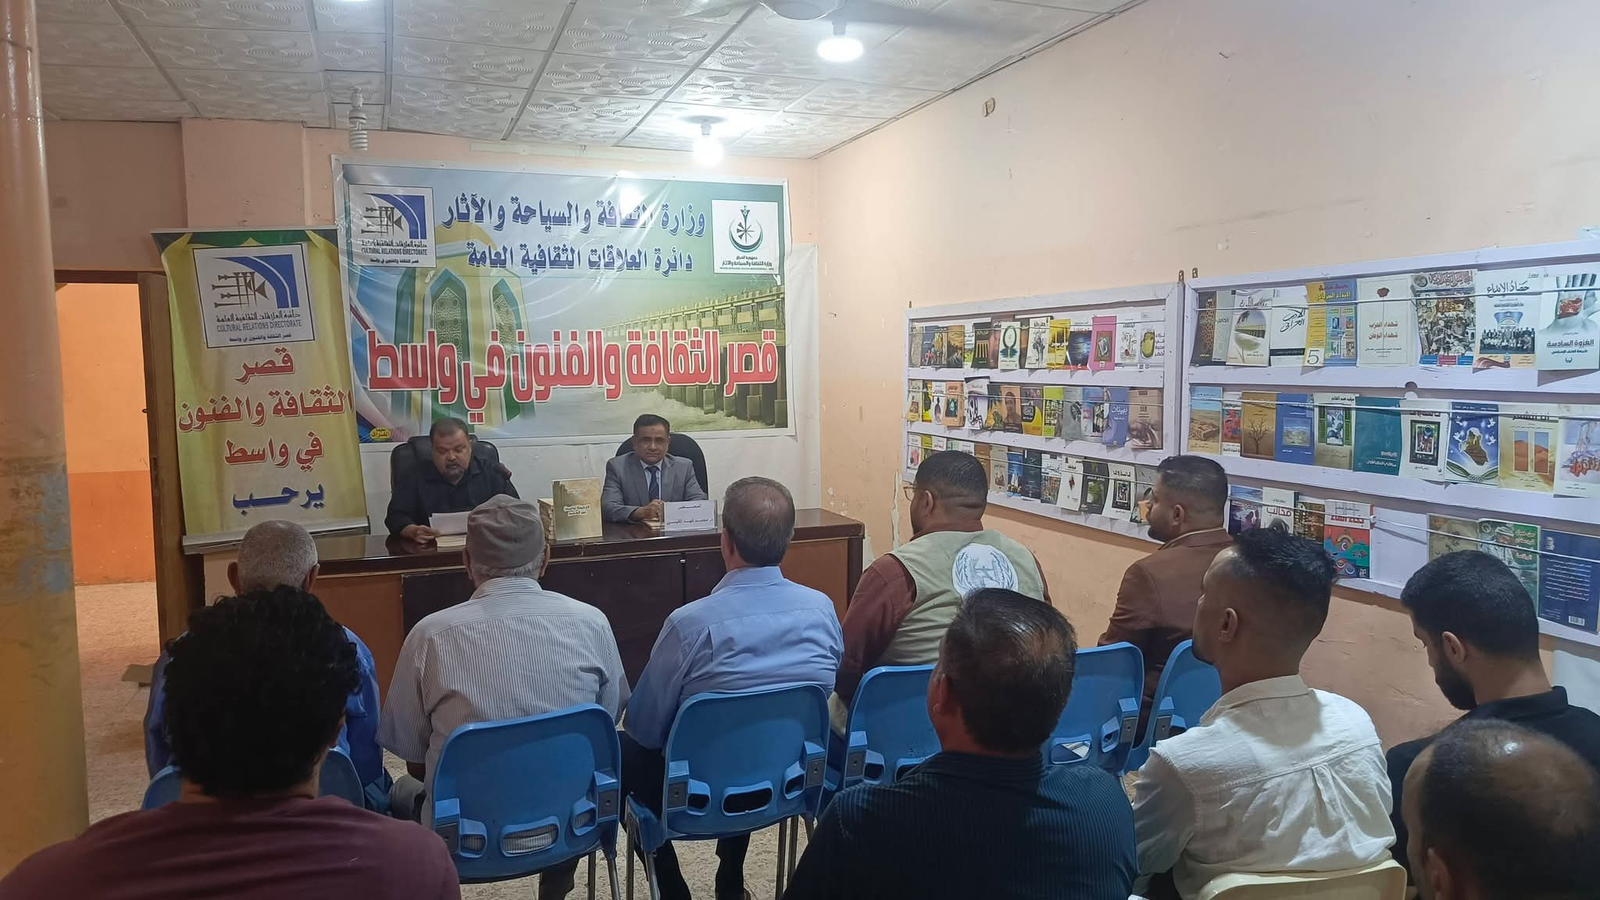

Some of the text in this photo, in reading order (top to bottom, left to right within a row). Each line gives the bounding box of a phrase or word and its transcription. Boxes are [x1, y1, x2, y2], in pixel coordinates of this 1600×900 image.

[441, 192, 506, 230] والآثار
[510, 196, 591, 233] والسياحة
[661, 203, 706, 237] وزارة
[402, 248, 428, 256] DIRECTORATE
[467, 242, 693, 277] دائرة العلاقات الثقافية العامة
[216, 319, 302, 332] CULTURAL RELATIONS DIRECTORATE
[235, 347, 295, 385] قصر
[367, 326, 779, 425] قصر الثقافة والفنون في واسط
[1306, 350, 1320, 365] 5
[178, 385, 355, 433] الثقافة والفنون
[224, 431, 324, 472] في واسط
[232, 483, 326, 517] يرحب
